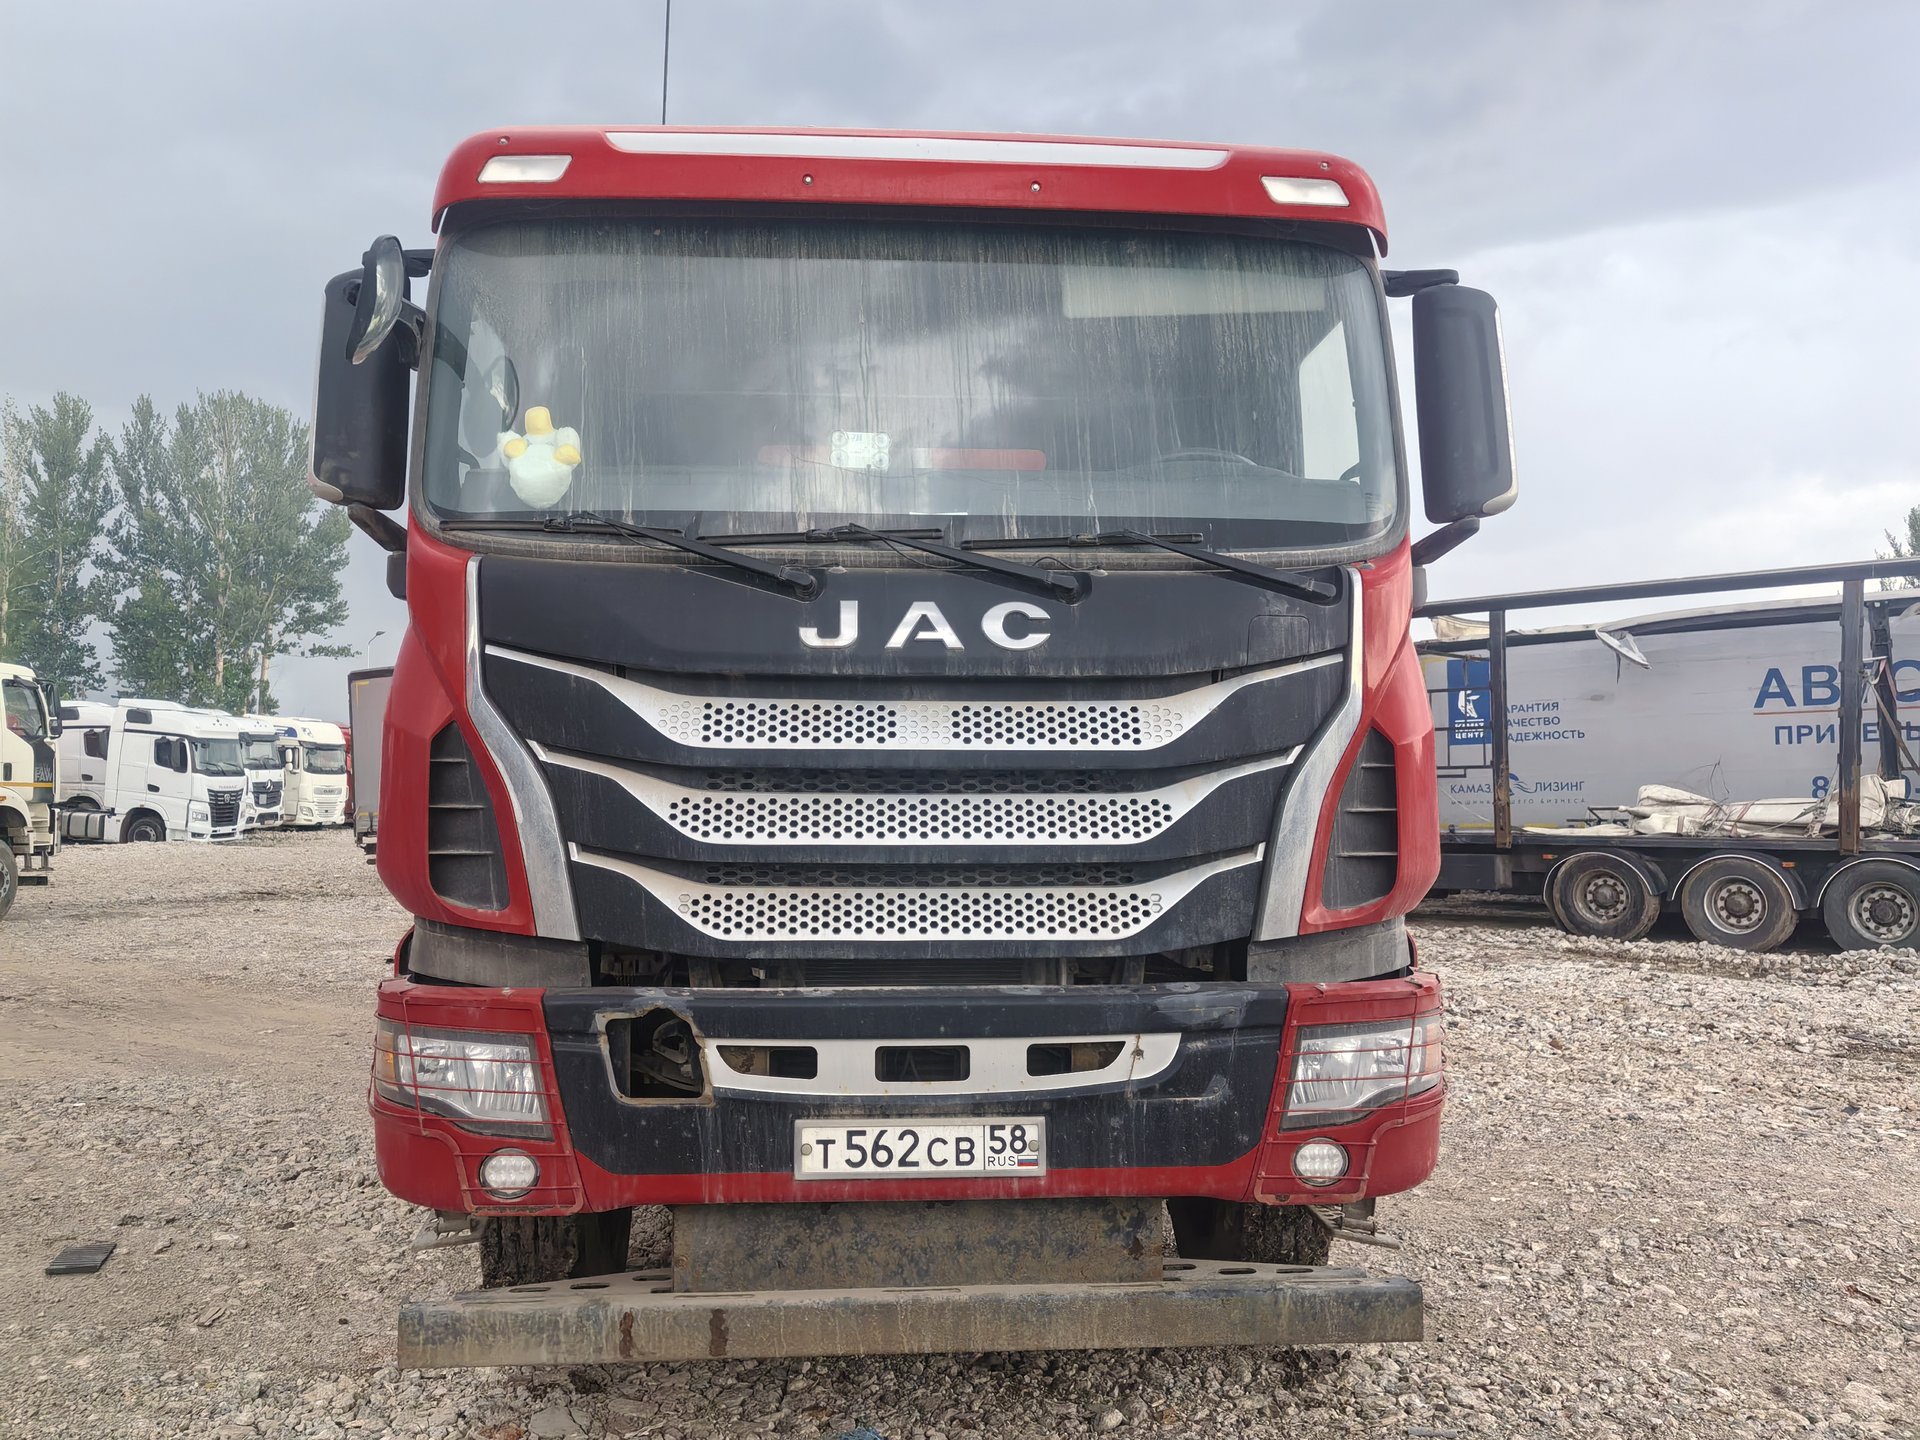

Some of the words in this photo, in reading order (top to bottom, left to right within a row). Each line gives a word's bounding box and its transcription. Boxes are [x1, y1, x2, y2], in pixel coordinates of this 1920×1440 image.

[799, 600, 1051, 650] JAC
[1505, 701, 1560, 714] АРАНТИЯ
[1506, 716, 1561, 728] АЧЕСТВО
[1507, 729, 1586, 743] АДЕЖНОСТЬ
[1450, 783, 1492, 794] КАМАЗ
[1534, 781, 1585, 793] ЛИЗИНГ
[815, 1129, 976, 1170] Т562СВ
[988, 1124, 1027, 1155] 58
[987, 1155, 1016, 1167] RUS
